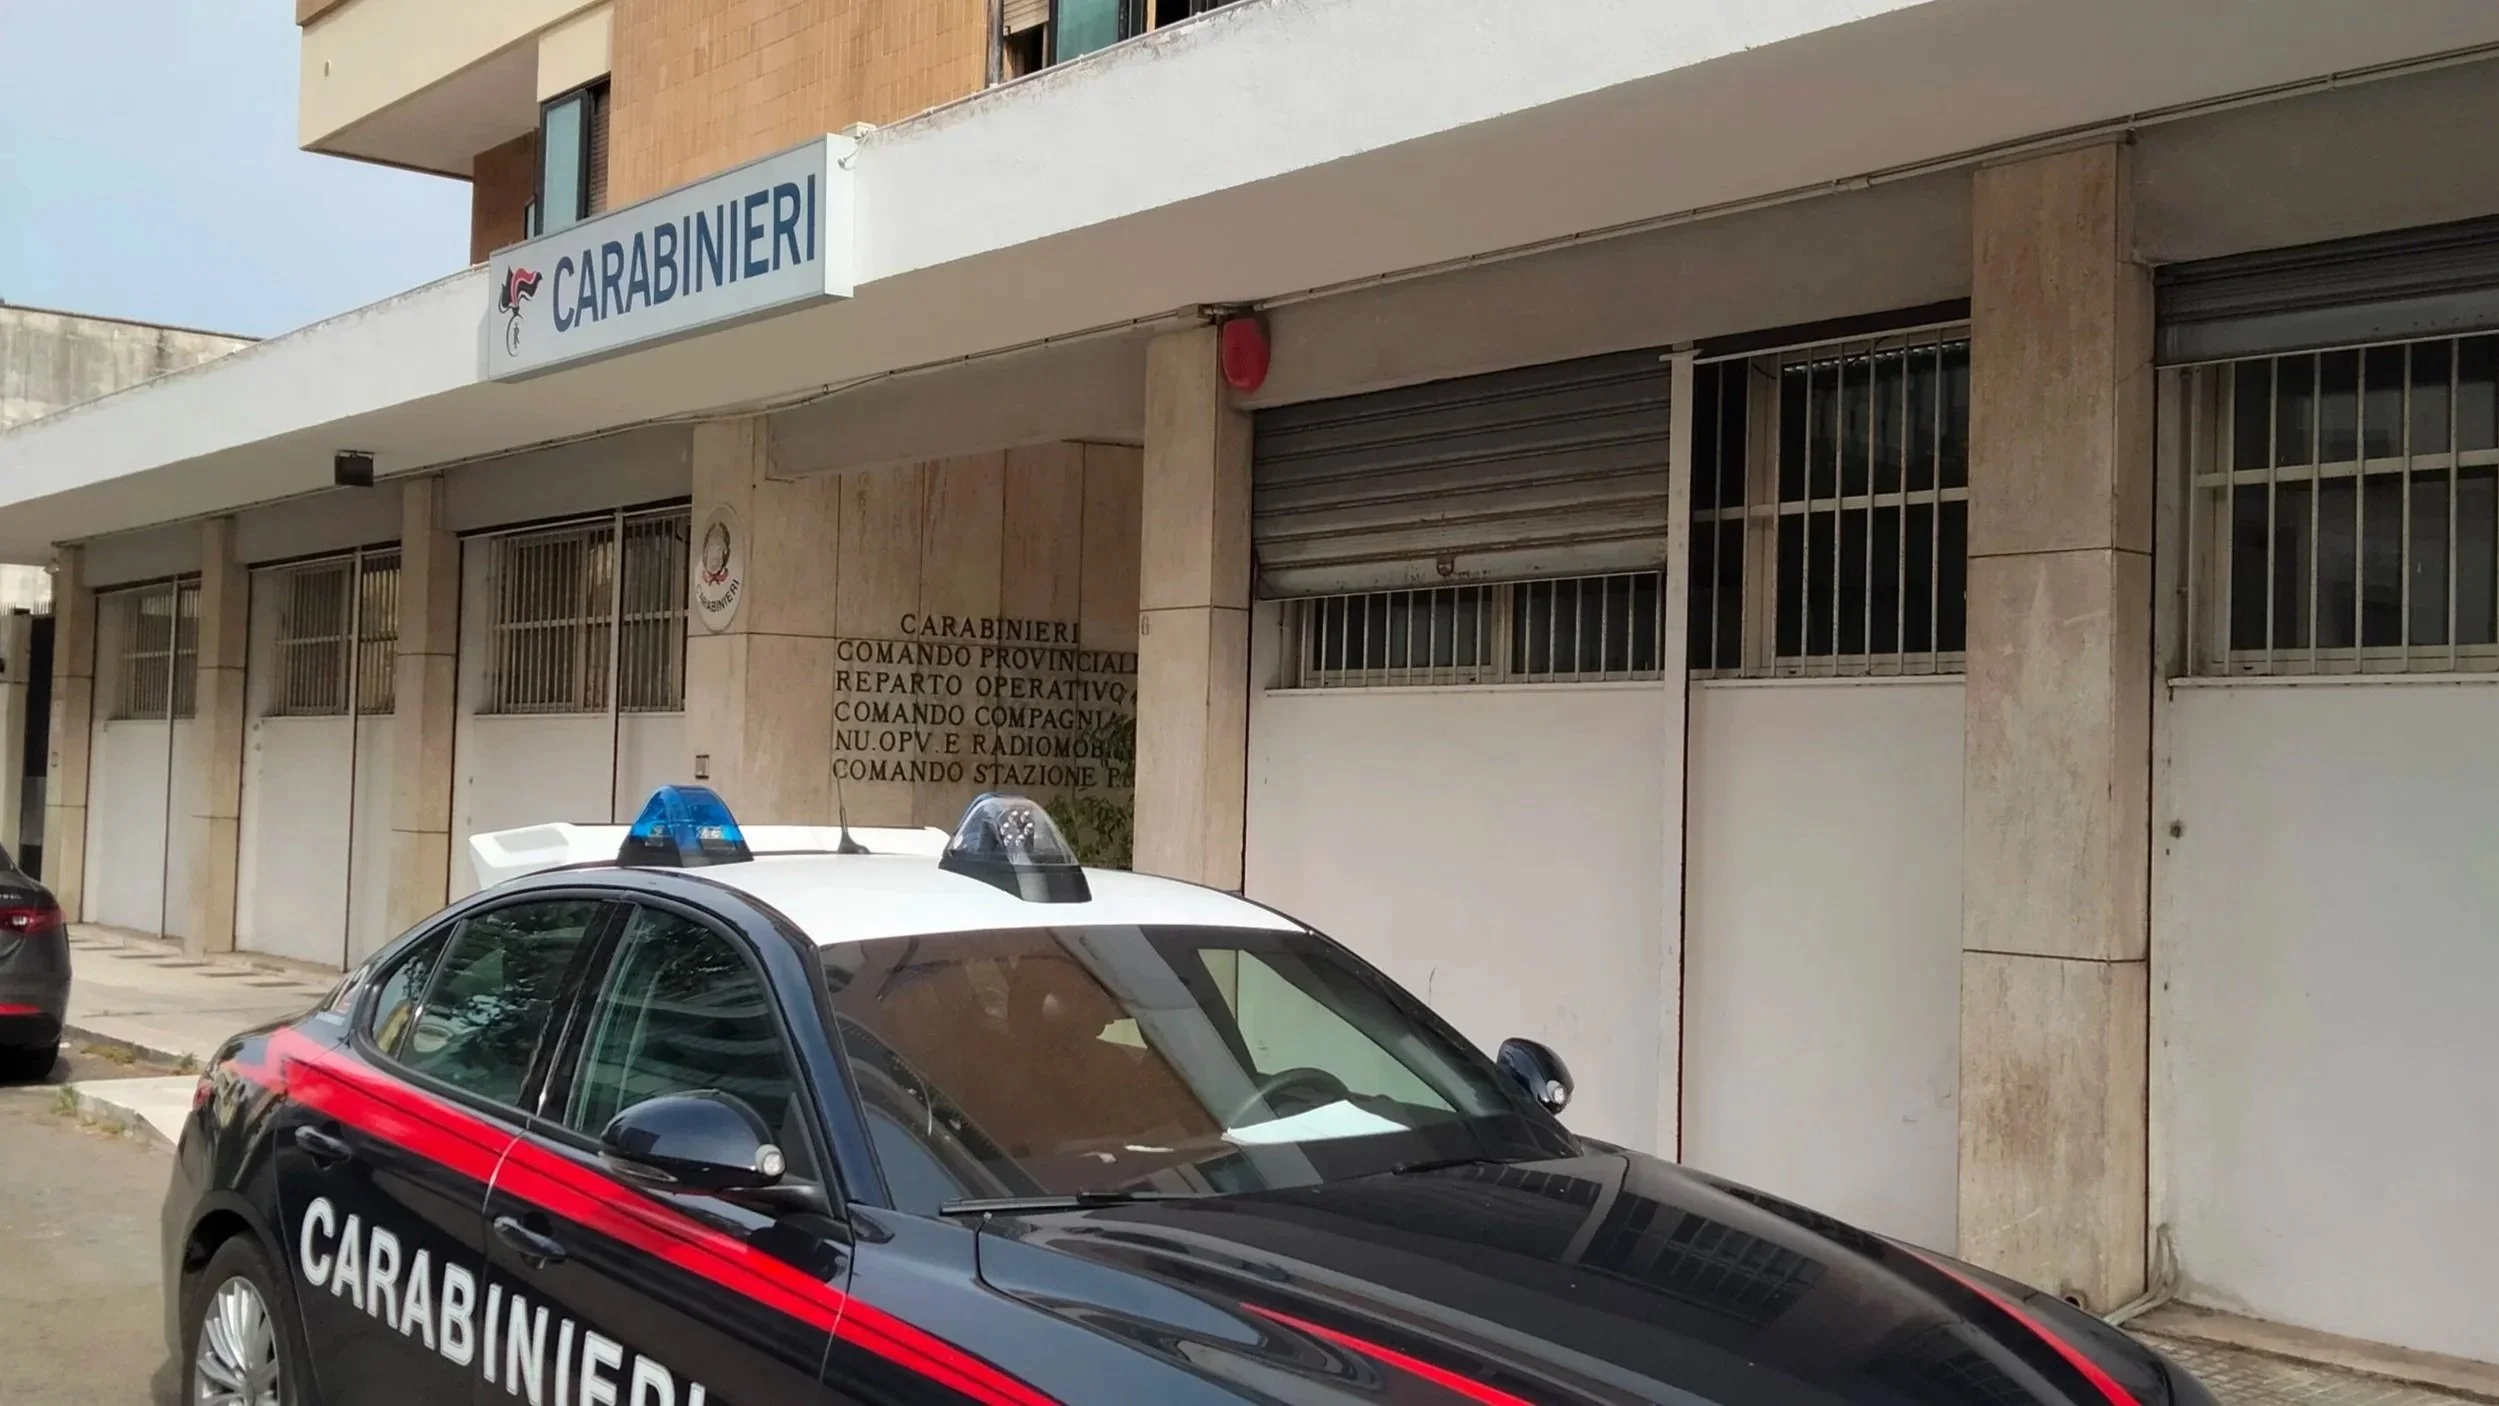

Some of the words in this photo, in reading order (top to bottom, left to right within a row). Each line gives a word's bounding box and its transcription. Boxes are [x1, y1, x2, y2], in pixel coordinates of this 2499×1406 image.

[553, 174, 816, 332] CARABINIERI
[900, 614, 1080, 643] CARABINIERI
[837, 640, 971, 667] COMANDO
[836, 670, 962, 695] REPARTO
[975, 675, 1126, 703] OPERATIVO
[834, 701, 965, 726] COMANDO
[972, 734, 1111, 759] RADIOMOB
[832, 758, 964, 783] COMANDO
[973, 764, 1097, 787] STAZIONE
[300, 1197, 706, 1406] CARABINIER
